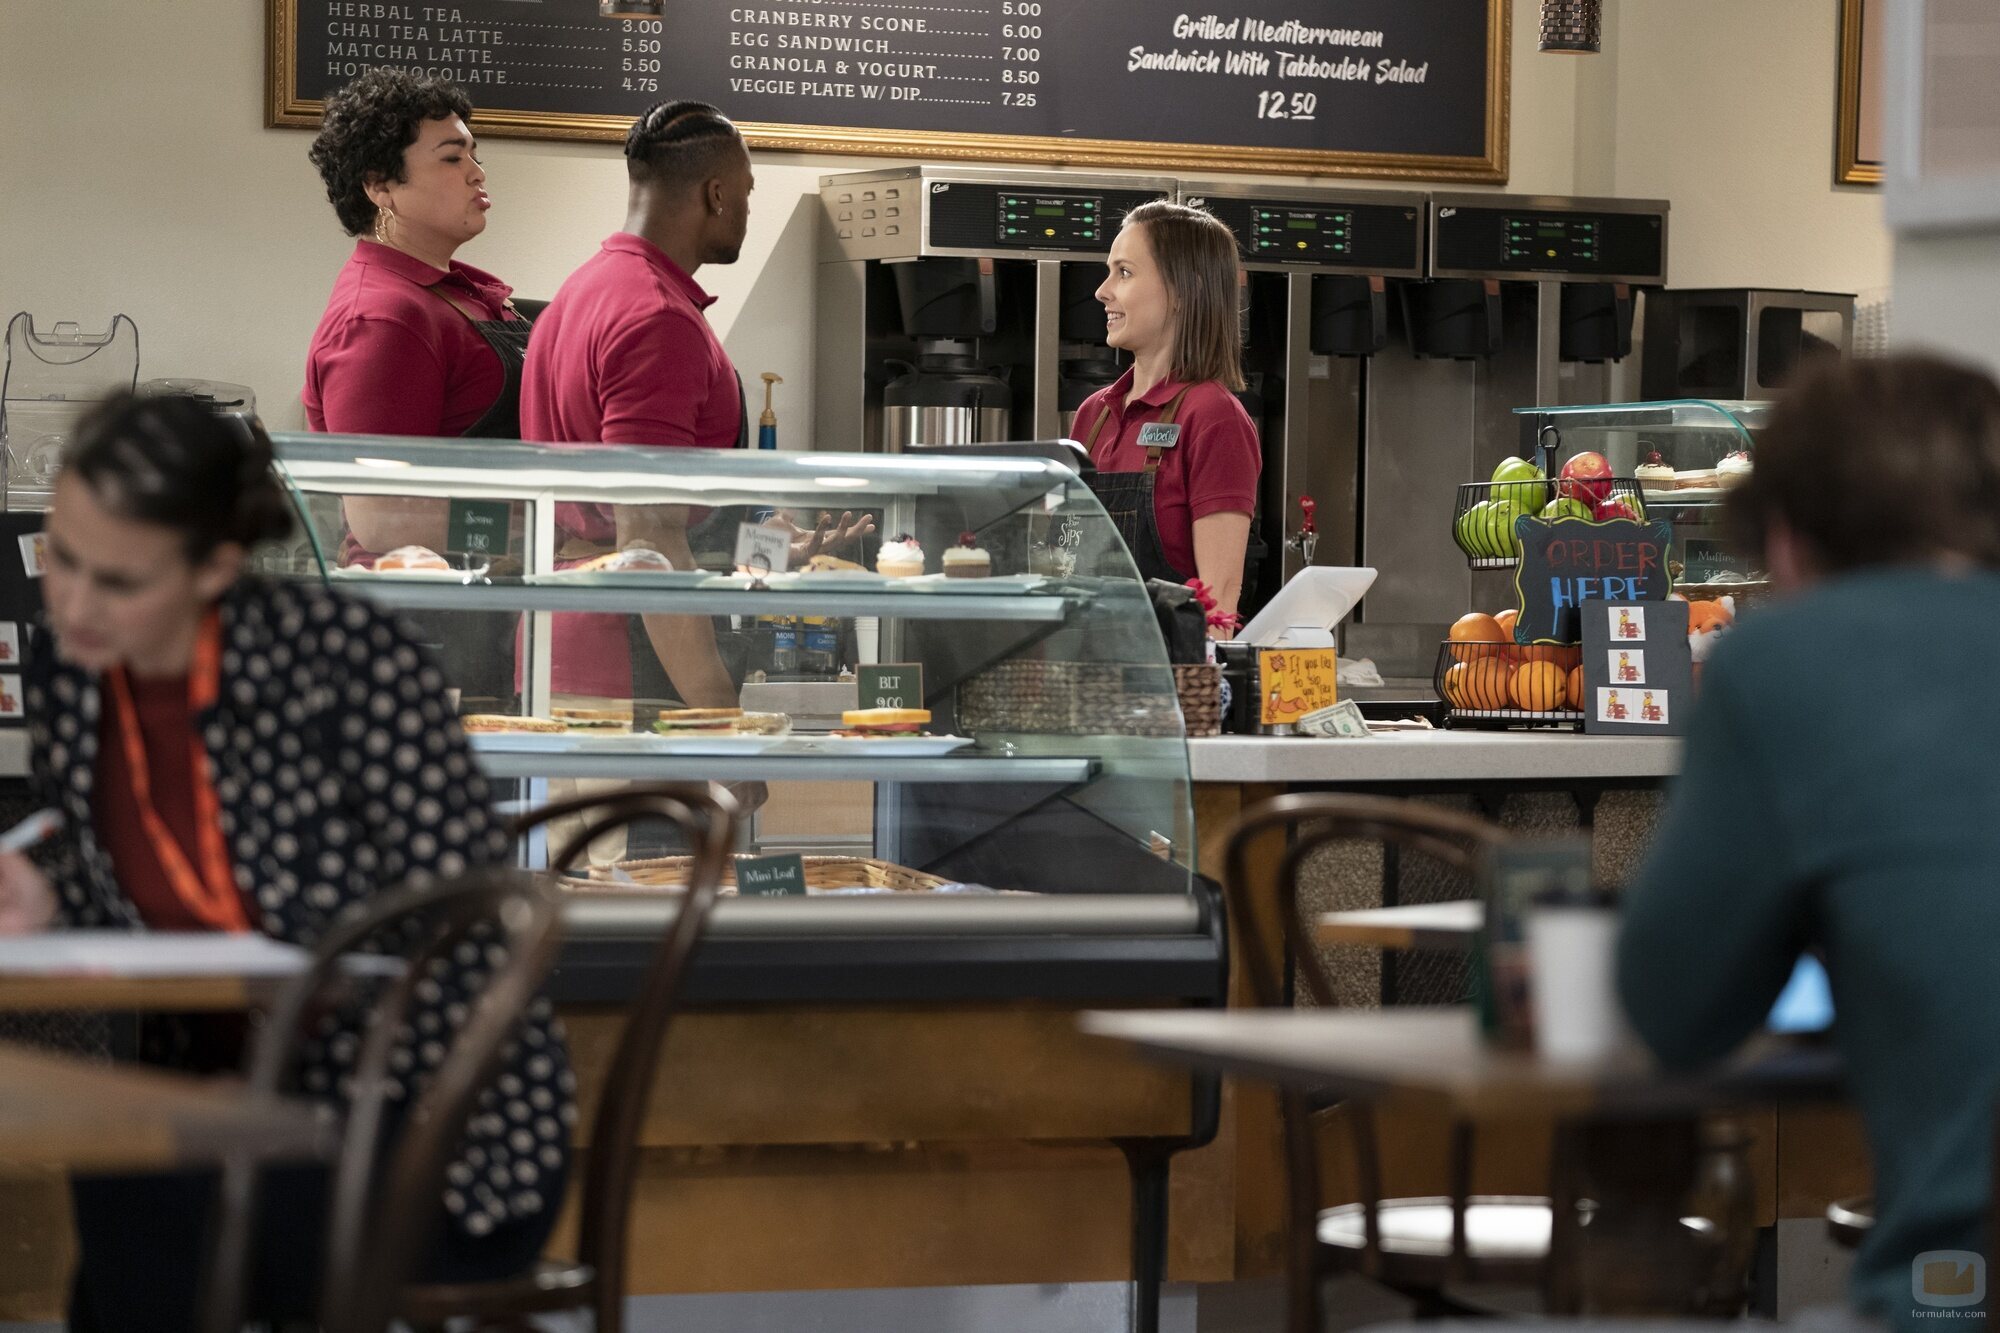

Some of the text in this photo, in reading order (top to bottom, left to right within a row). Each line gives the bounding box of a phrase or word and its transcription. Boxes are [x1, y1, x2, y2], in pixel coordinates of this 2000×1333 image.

[328, 2, 463, 23] HERBAL TEA
[1001, 1, 1042, 17] 5.00
[622, 19, 663, 34] 3.00
[730, 8, 927, 33] CRANBERRY SCONE
[1172, 13, 1384, 48] Grilled Mediterranean
[327, 22, 503, 45] CHAI TEA LATTE
[730, 31, 889, 54] EGG SANDWICH
[1002, 24, 1042, 40] 6.00
[327, 41, 493, 64] MATCHA LATTE
[622, 38, 661, 54] 5.50
[1001, 46, 1040, 62] 7.00
[621, 57, 661, 73] 5.50
[730, 54, 938, 79] GRANOLA & YOGURT
[1127, 45, 1429, 85] Sandwich With Tabbouleh Salad
[621, 77, 659, 92] 4.75
[1001, 69, 1040, 85] 8.50
[729, 78, 921, 101] VEGGIE PLATE W/ DIP
[1001, 92, 1037, 108] 7.25
[1257, 89, 1318, 121] 12.50
[1546, 540, 1658, 570] ORDER
[1551, 576, 1649, 608] HERE
[879, 676, 901, 689] BLT
[745, 869, 772, 884] Mini
